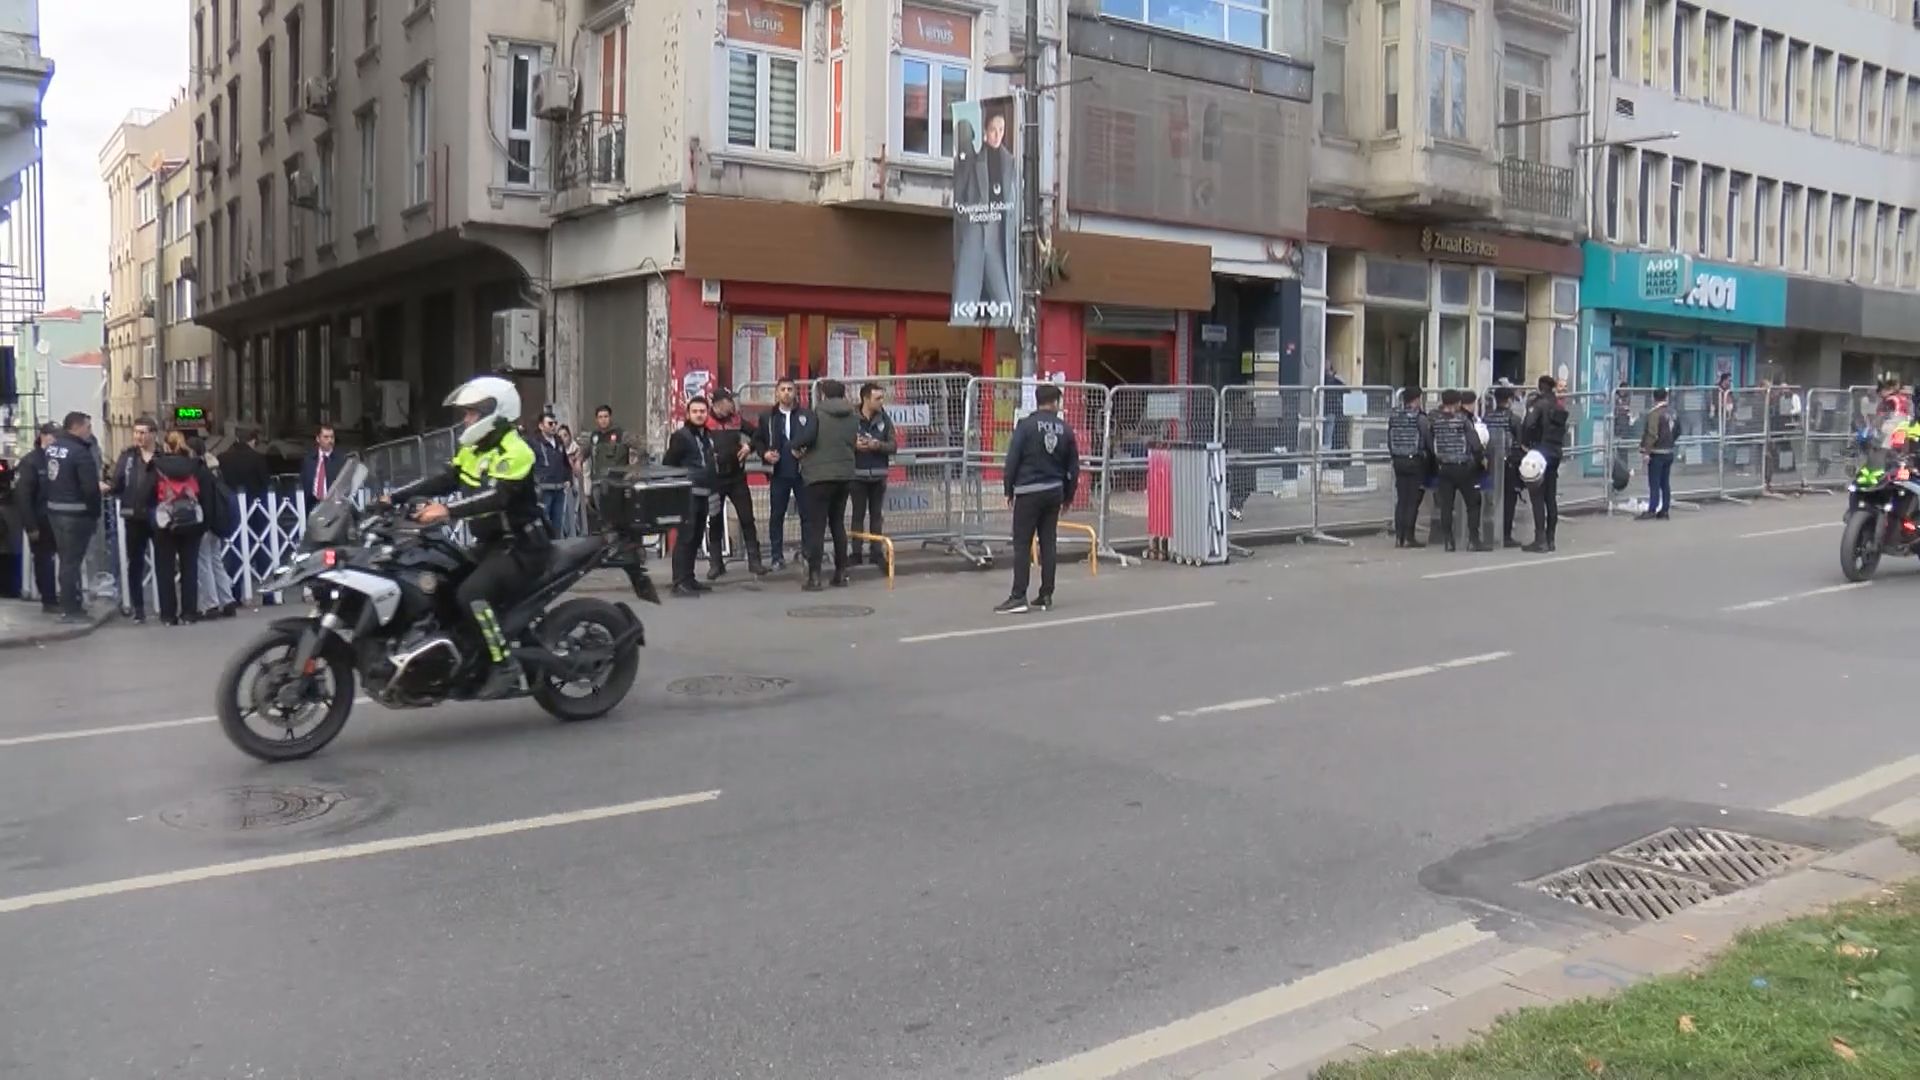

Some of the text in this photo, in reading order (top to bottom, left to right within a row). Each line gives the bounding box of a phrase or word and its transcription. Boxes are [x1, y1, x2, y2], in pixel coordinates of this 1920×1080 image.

[745, 8, 784, 33] Venus
[917, 16, 954, 43] Venus
[1434, 231, 1462, 252] Ziraat
[1647, 258, 1679, 272] A101
[954, 301, 1012, 317] KOTON
